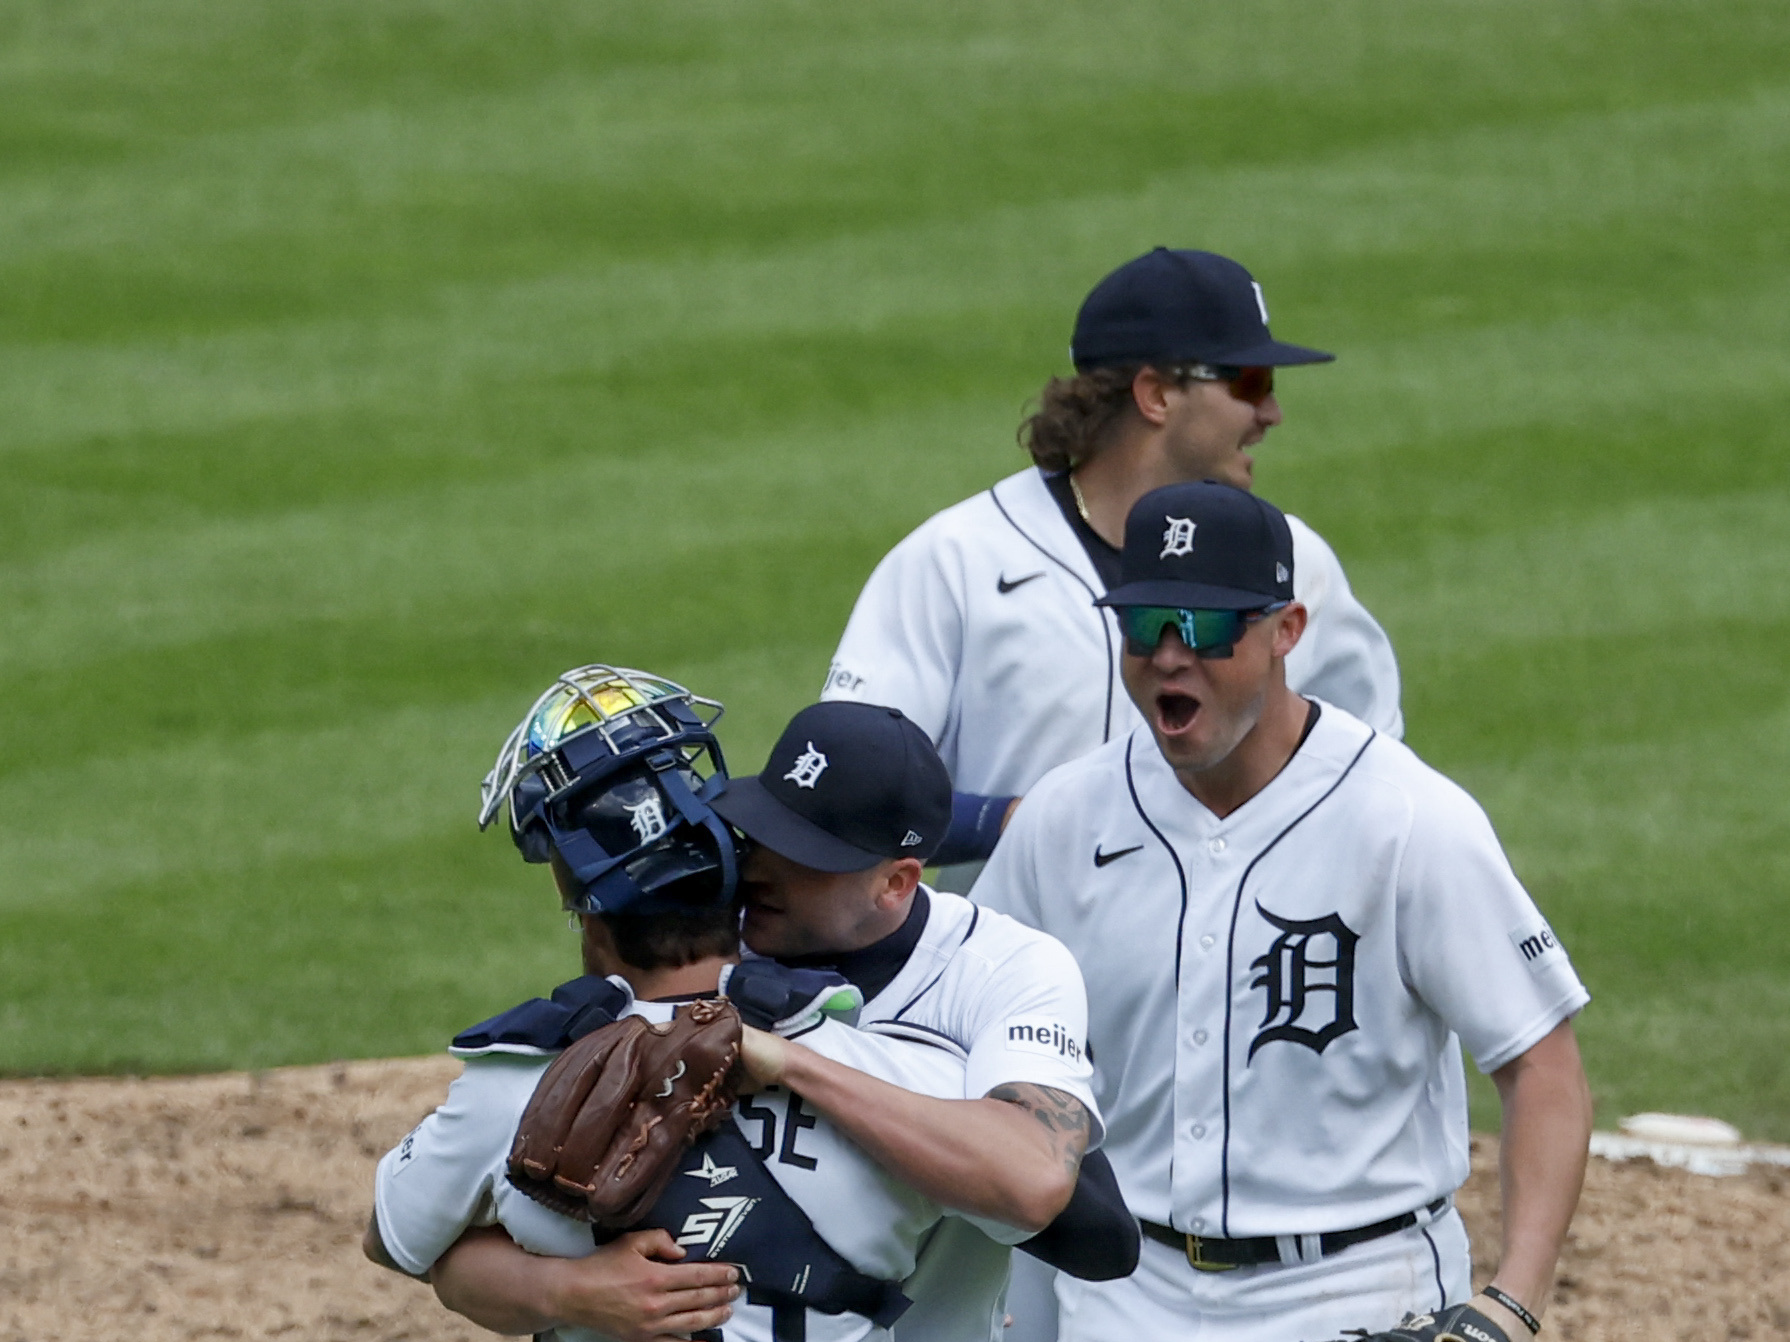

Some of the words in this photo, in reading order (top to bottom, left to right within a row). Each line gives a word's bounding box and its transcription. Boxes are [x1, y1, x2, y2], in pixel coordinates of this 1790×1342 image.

[1160, 515, 1197, 560] D
[783, 741, 829, 789] D
[1247, 897, 1361, 1068] D
[1008, 1023, 1081, 1063] meijer
